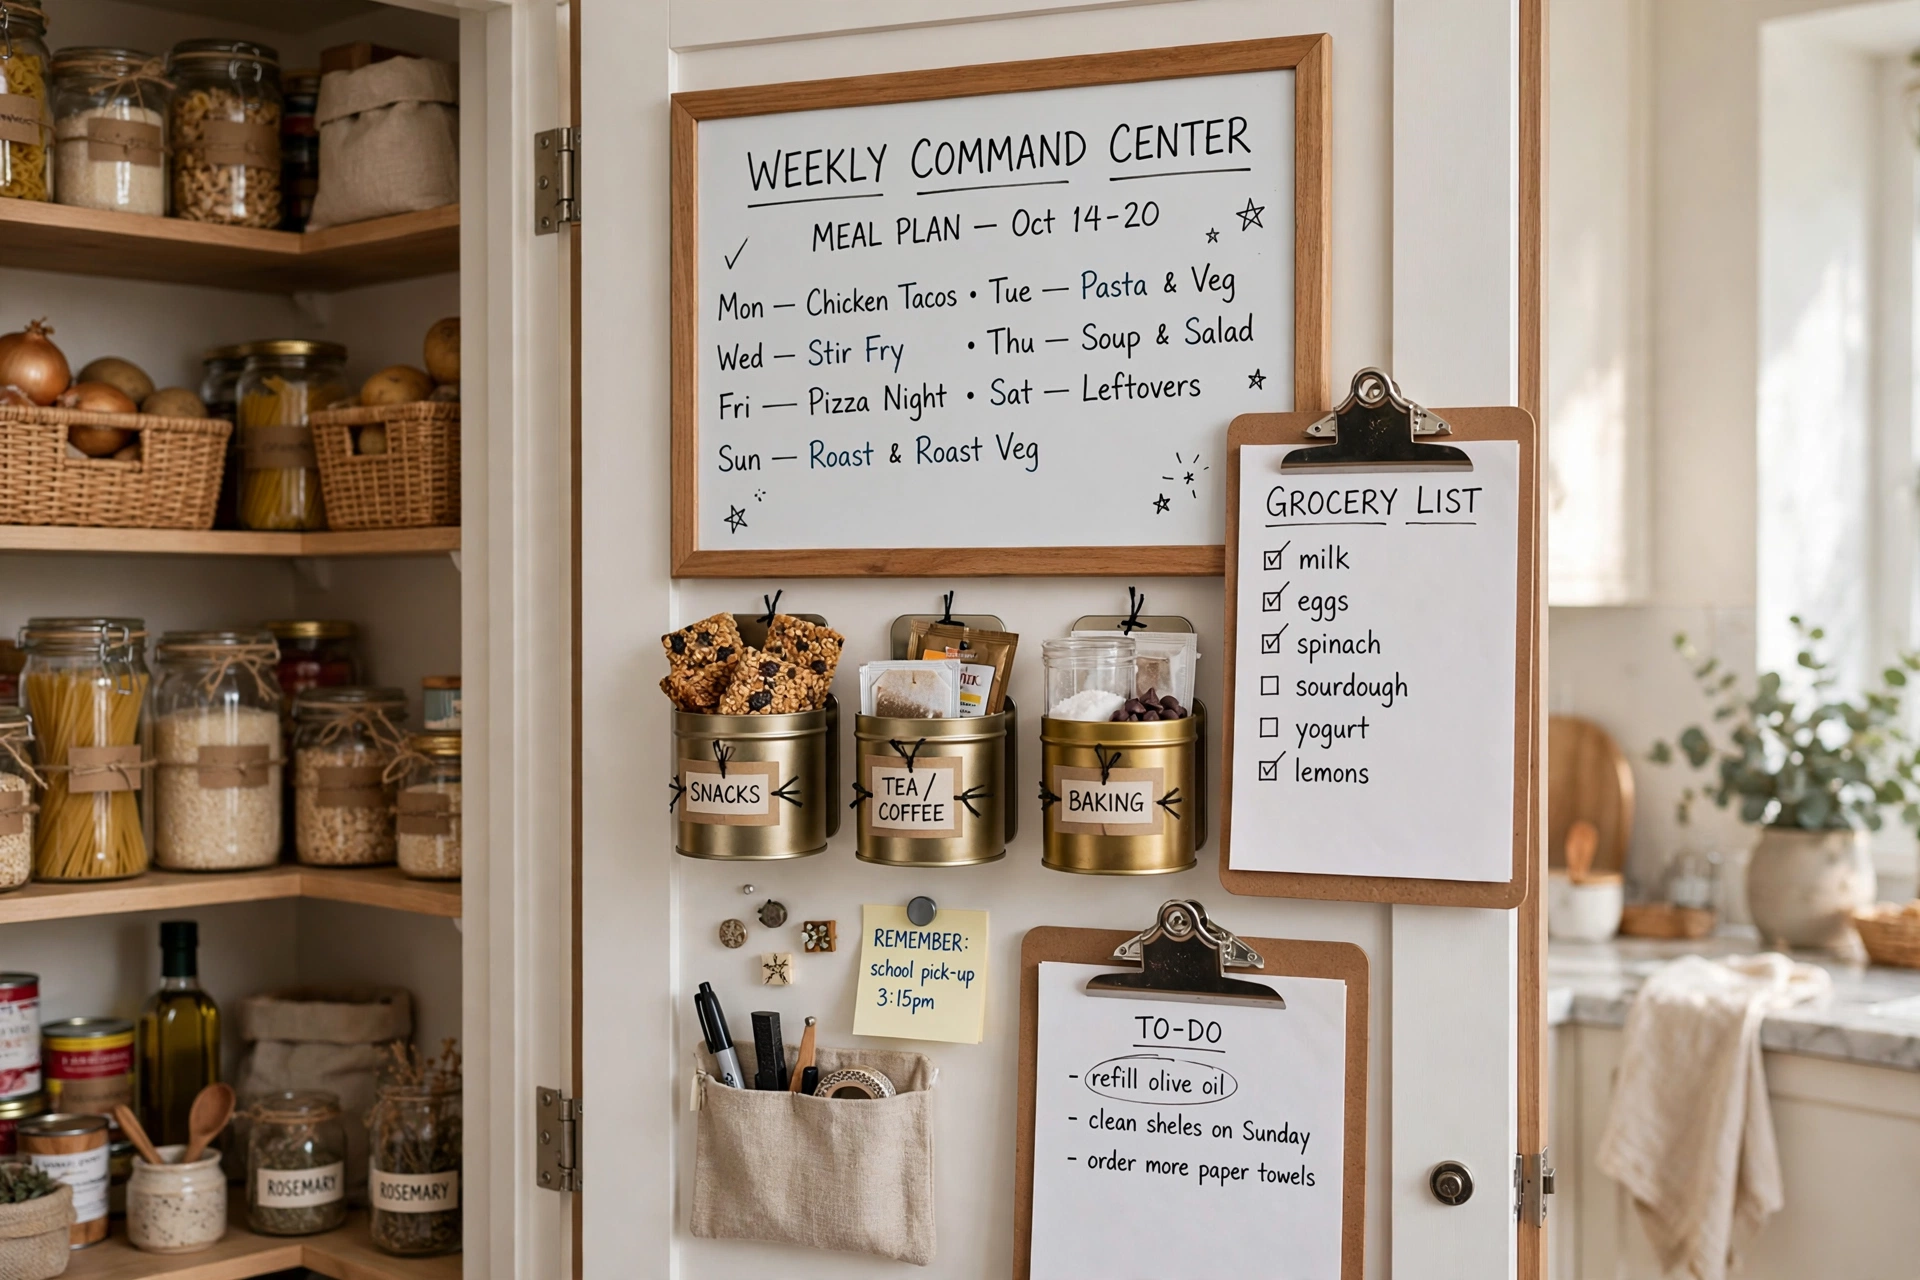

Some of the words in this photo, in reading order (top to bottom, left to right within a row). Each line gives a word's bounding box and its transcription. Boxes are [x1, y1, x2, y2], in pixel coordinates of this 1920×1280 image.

[746, 143, 888, 192] WEEKLY
[910, 130, 1087, 179] COMMAND
[1109, 115, 1252, 164] CENTER
[812, 221, 883, 253] MEAL
[895, 213, 961, 246] PLAN
[1011, 208, 1056, 238] Oct
[1073, 200, 1160, 233] 14-20
[717, 291, 764, 322] Mon
[806, 287, 889, 317] Chicken
[897, 281, 958, 310] Tacos
[988, 276, 1033, 305] Tue
[1080, 269, 1148, 300] Pasta
[1163, 271, 1177, 294] &
[1190, 262, 1236, 304] Veg
[716, 341, 764, 372] Wed
[808, 338, 853, 367] Stir
[865, 334, 905, 374] Fry
[986, 326, 1035, 356] Thu
[1081, 322, 1141, 360] Soup
[1155, 322, 1170, 346] &
[1184, 312, 1254, 346] Salad
[719, 391, 750, 421] Fri
[808, 386, 871, 416] Pizza
[884, 381, 948, 422] Night
[989, 377, 1034, 407] Sat
[1082, 370, 1202, 403] Leftovers
[718, 444, 761, 473] Sun
[808, 439, 875, 470] Roast
[888, 442, 902, 464] &
[915, 434, 984, 465] Roast
[995, 431, 1039, 473] Veg
[1266, 485, 1399, 518] GROCERY
[1416, 485, 1483, 515] LIST
[1299, 543, 1350, 570] milk
[1297, 594, 1349, 623] eggs
[1296, 628, 1381, 665] spinach
[1295, 671, 1409, 709] sourdough
[1295, 715, 1370, 750] yogurt
[1295, 756, 1370, 785] lemons
[690, 781, 761, 804] SNACKS
[1069, 789, 1145, 813] BAKING
[878, 801, 945, 823] COFFEE
[873, 927, 969, 953] REMEMBER:
[870, 958, 915, 979] school
[920, 961, 976, 990] pick-up
[876, 987, 935, 1016] 3:15pm
[1134, 1015, 1222, 1044] TO-DO
[1092, 1065, 1138, 1090] refill
[1148, 1068, 1193, 1094] olive
[1202, 1072, 1225, 1096] oil
[1088, 1107, 1137, 1133] clean
[1146, 1111, 1203, 1137] sheles
[1211, 1124, 1233, 1140] on
[1242, 1119, 1311, 1156] Sunday
[1087, 1148, 1137, 1172] order
[1145, 1159, 1190, 1177] more
[1198, 1164, 1250, 1188] paper
[1256, 1161, 1316, 1187] towels
[267, 1174, 338, 1197] ROSEMARY
[379, 1181, 450, 1202] ROSEMARY
